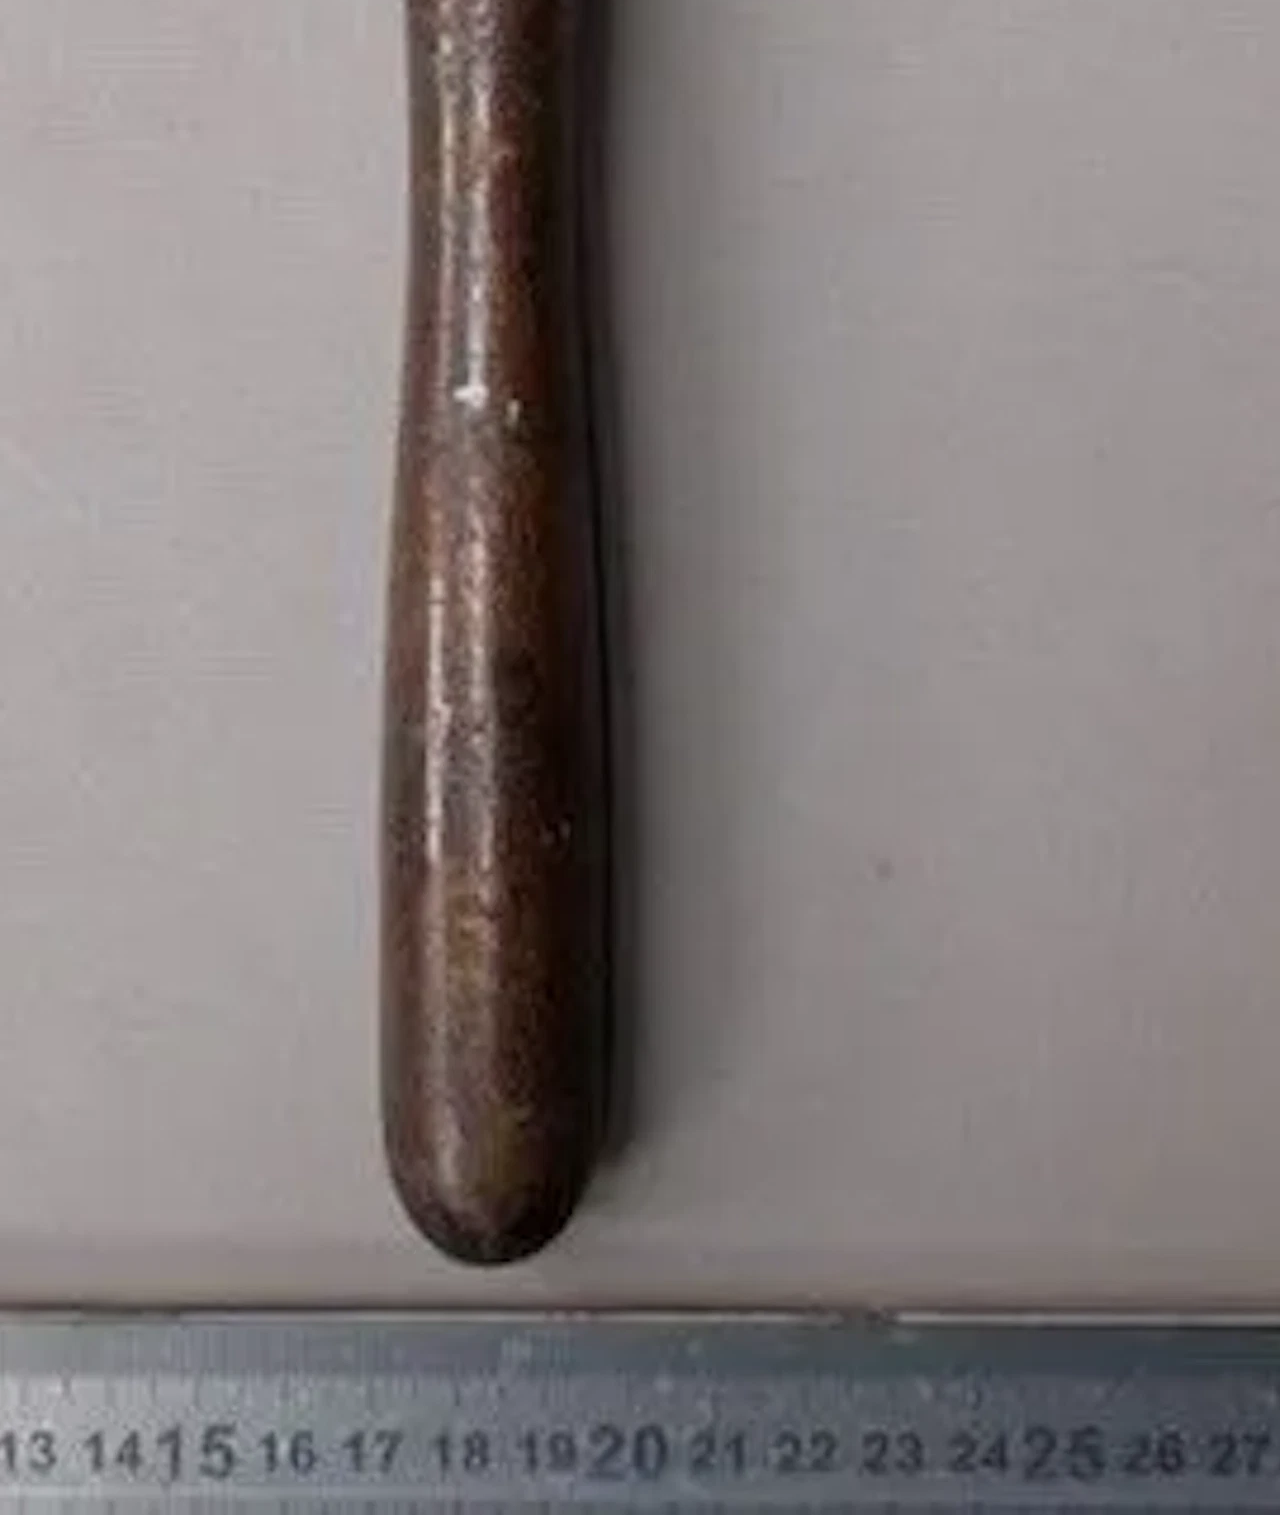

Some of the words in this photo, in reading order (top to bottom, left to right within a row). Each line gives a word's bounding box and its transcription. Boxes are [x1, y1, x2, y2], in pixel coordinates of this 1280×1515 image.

[83, 1431, 144, 1474] 14
[157, 1423, 238, 1480] 15
[256, 1431, 317, 1475] 16
[341, 1431, 404, 1475] 17
[432, 1431, 491, 1475] 18
[520, 1431, 578, 1474] 19
[588, 1425, 669, 1482] 20
[691, 1431, 746, 1475] 21
[774, 1431, 838, 1475] 22
[862, 1431, 923, 1476] 23
[949, 1431, 1009, 1476] 24
[1024, 1426, 1107, 1481] 25
[1123, 1432, 1187, 1477] 26
